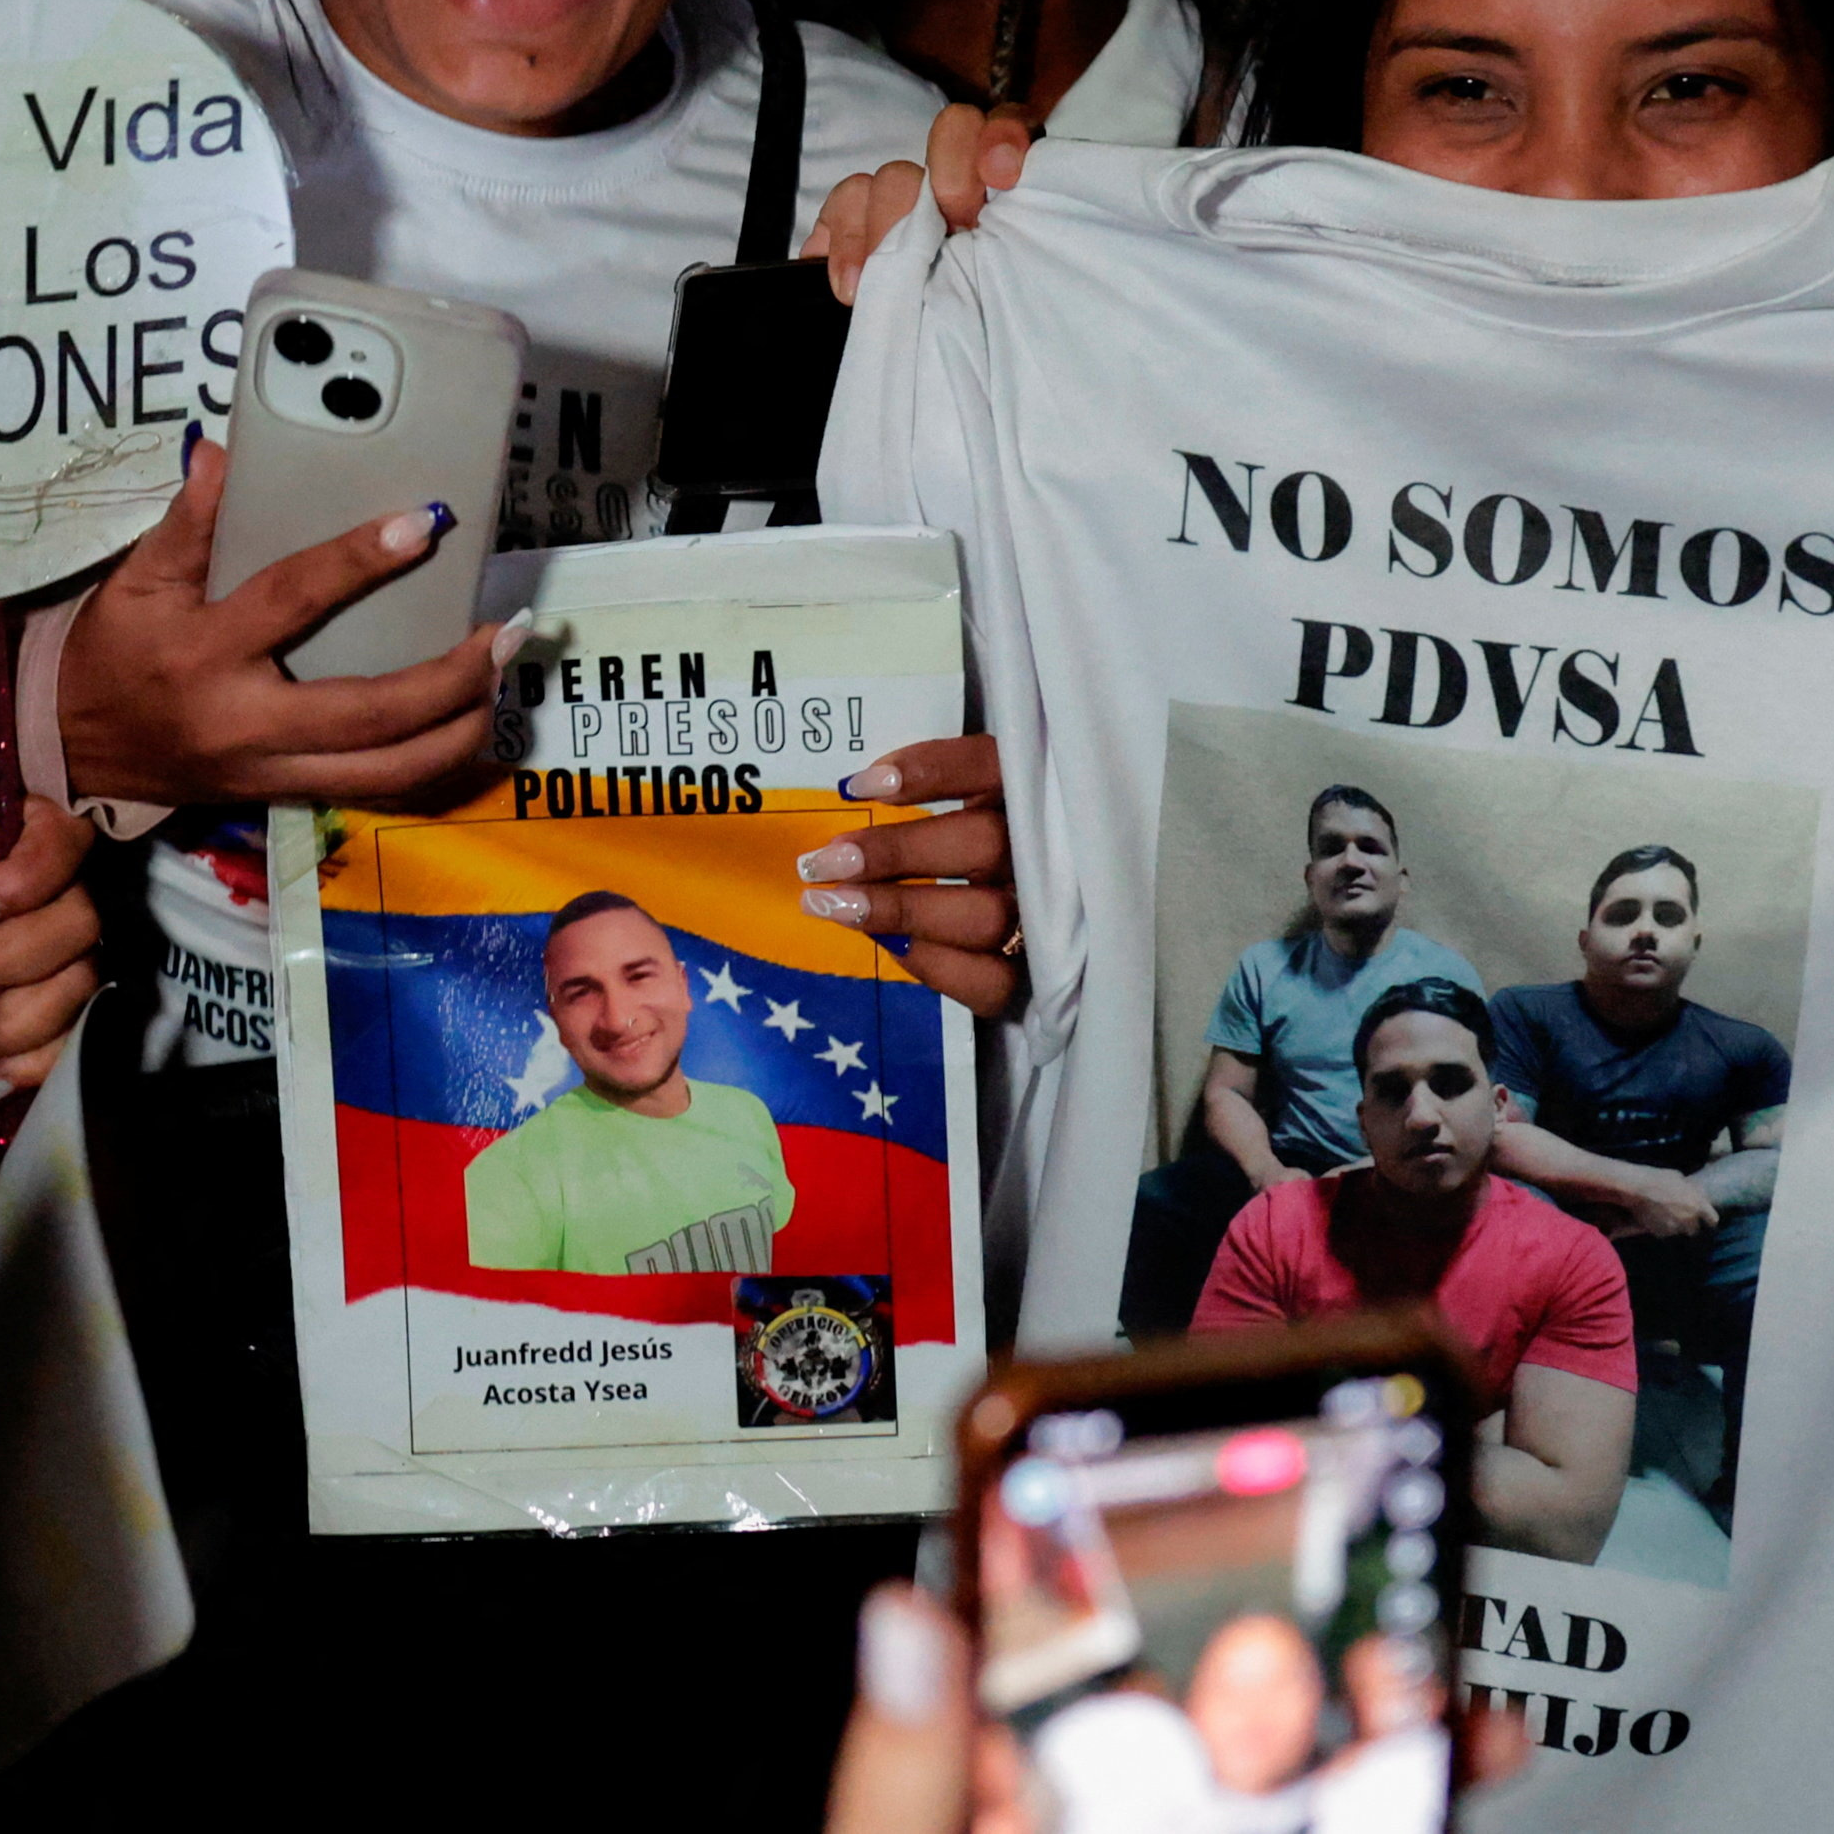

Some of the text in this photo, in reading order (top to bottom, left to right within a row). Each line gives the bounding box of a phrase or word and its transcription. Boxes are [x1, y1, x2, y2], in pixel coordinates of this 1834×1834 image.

[23, 78, 244, 171] Vida
[24, 225, 197, 305] Los
[1167, 449, 1354, 562] NO
[751, 649, 778, 698] A
[1284, 617, 1705, 757] PDVSA
[570, 696, 864, 758] PRESOS!
[513, 763, 763, 820] POLITICOS
[183, 993, 274, 1053] ACOS
[453, 1337, 673, 1373] Juanfredd Jesús
[482, 1380, 648, 1406] Acosta Ysea
